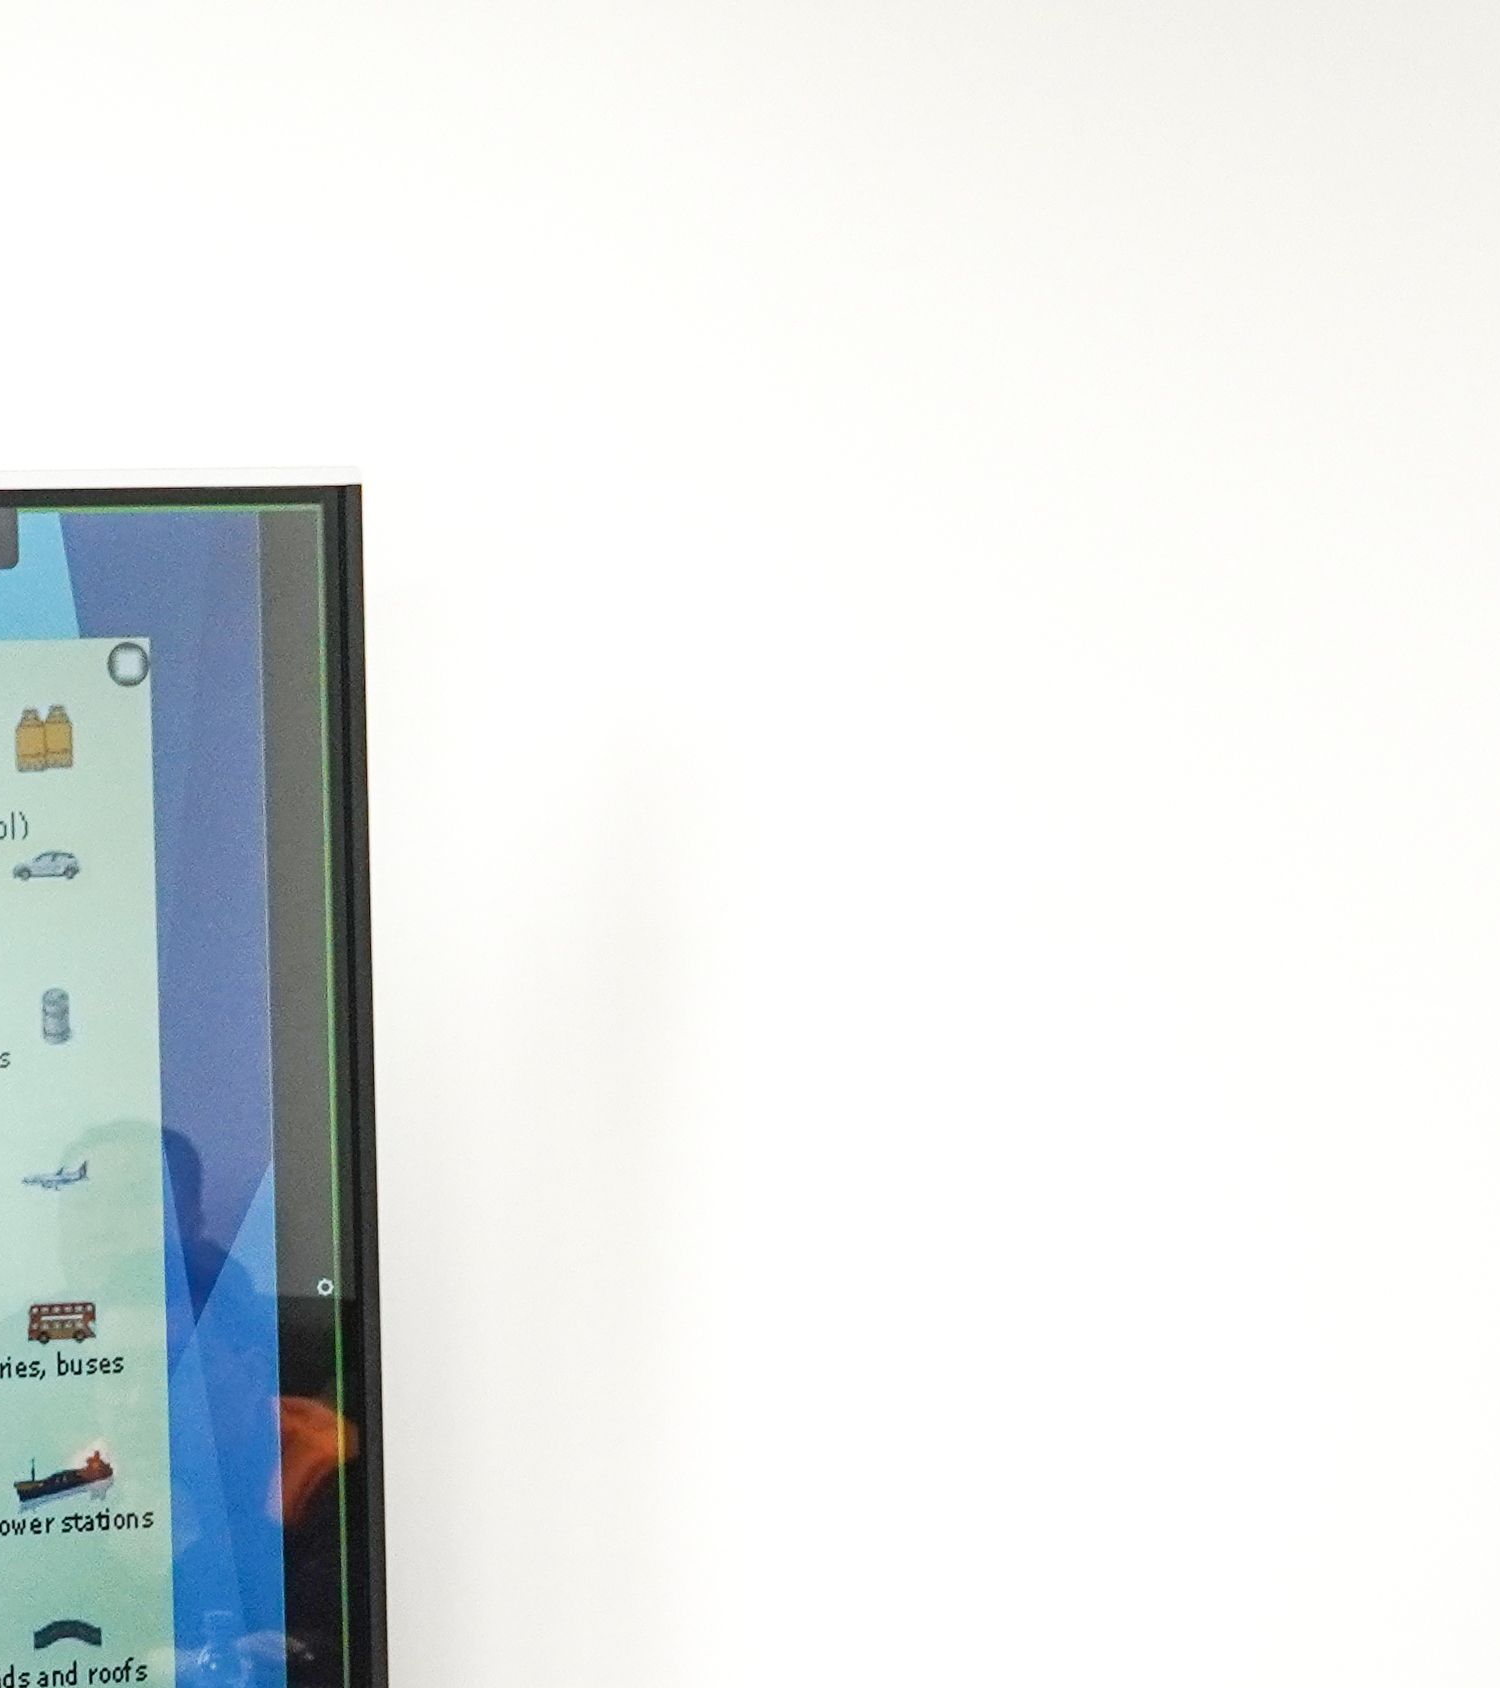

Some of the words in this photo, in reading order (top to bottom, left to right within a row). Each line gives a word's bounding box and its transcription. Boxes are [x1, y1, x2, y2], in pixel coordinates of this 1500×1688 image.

[56, 1350, 125, 1378] buses
[60, 1507, 155, 1534] stations
[86, 1660, 149, 1686] roofs
